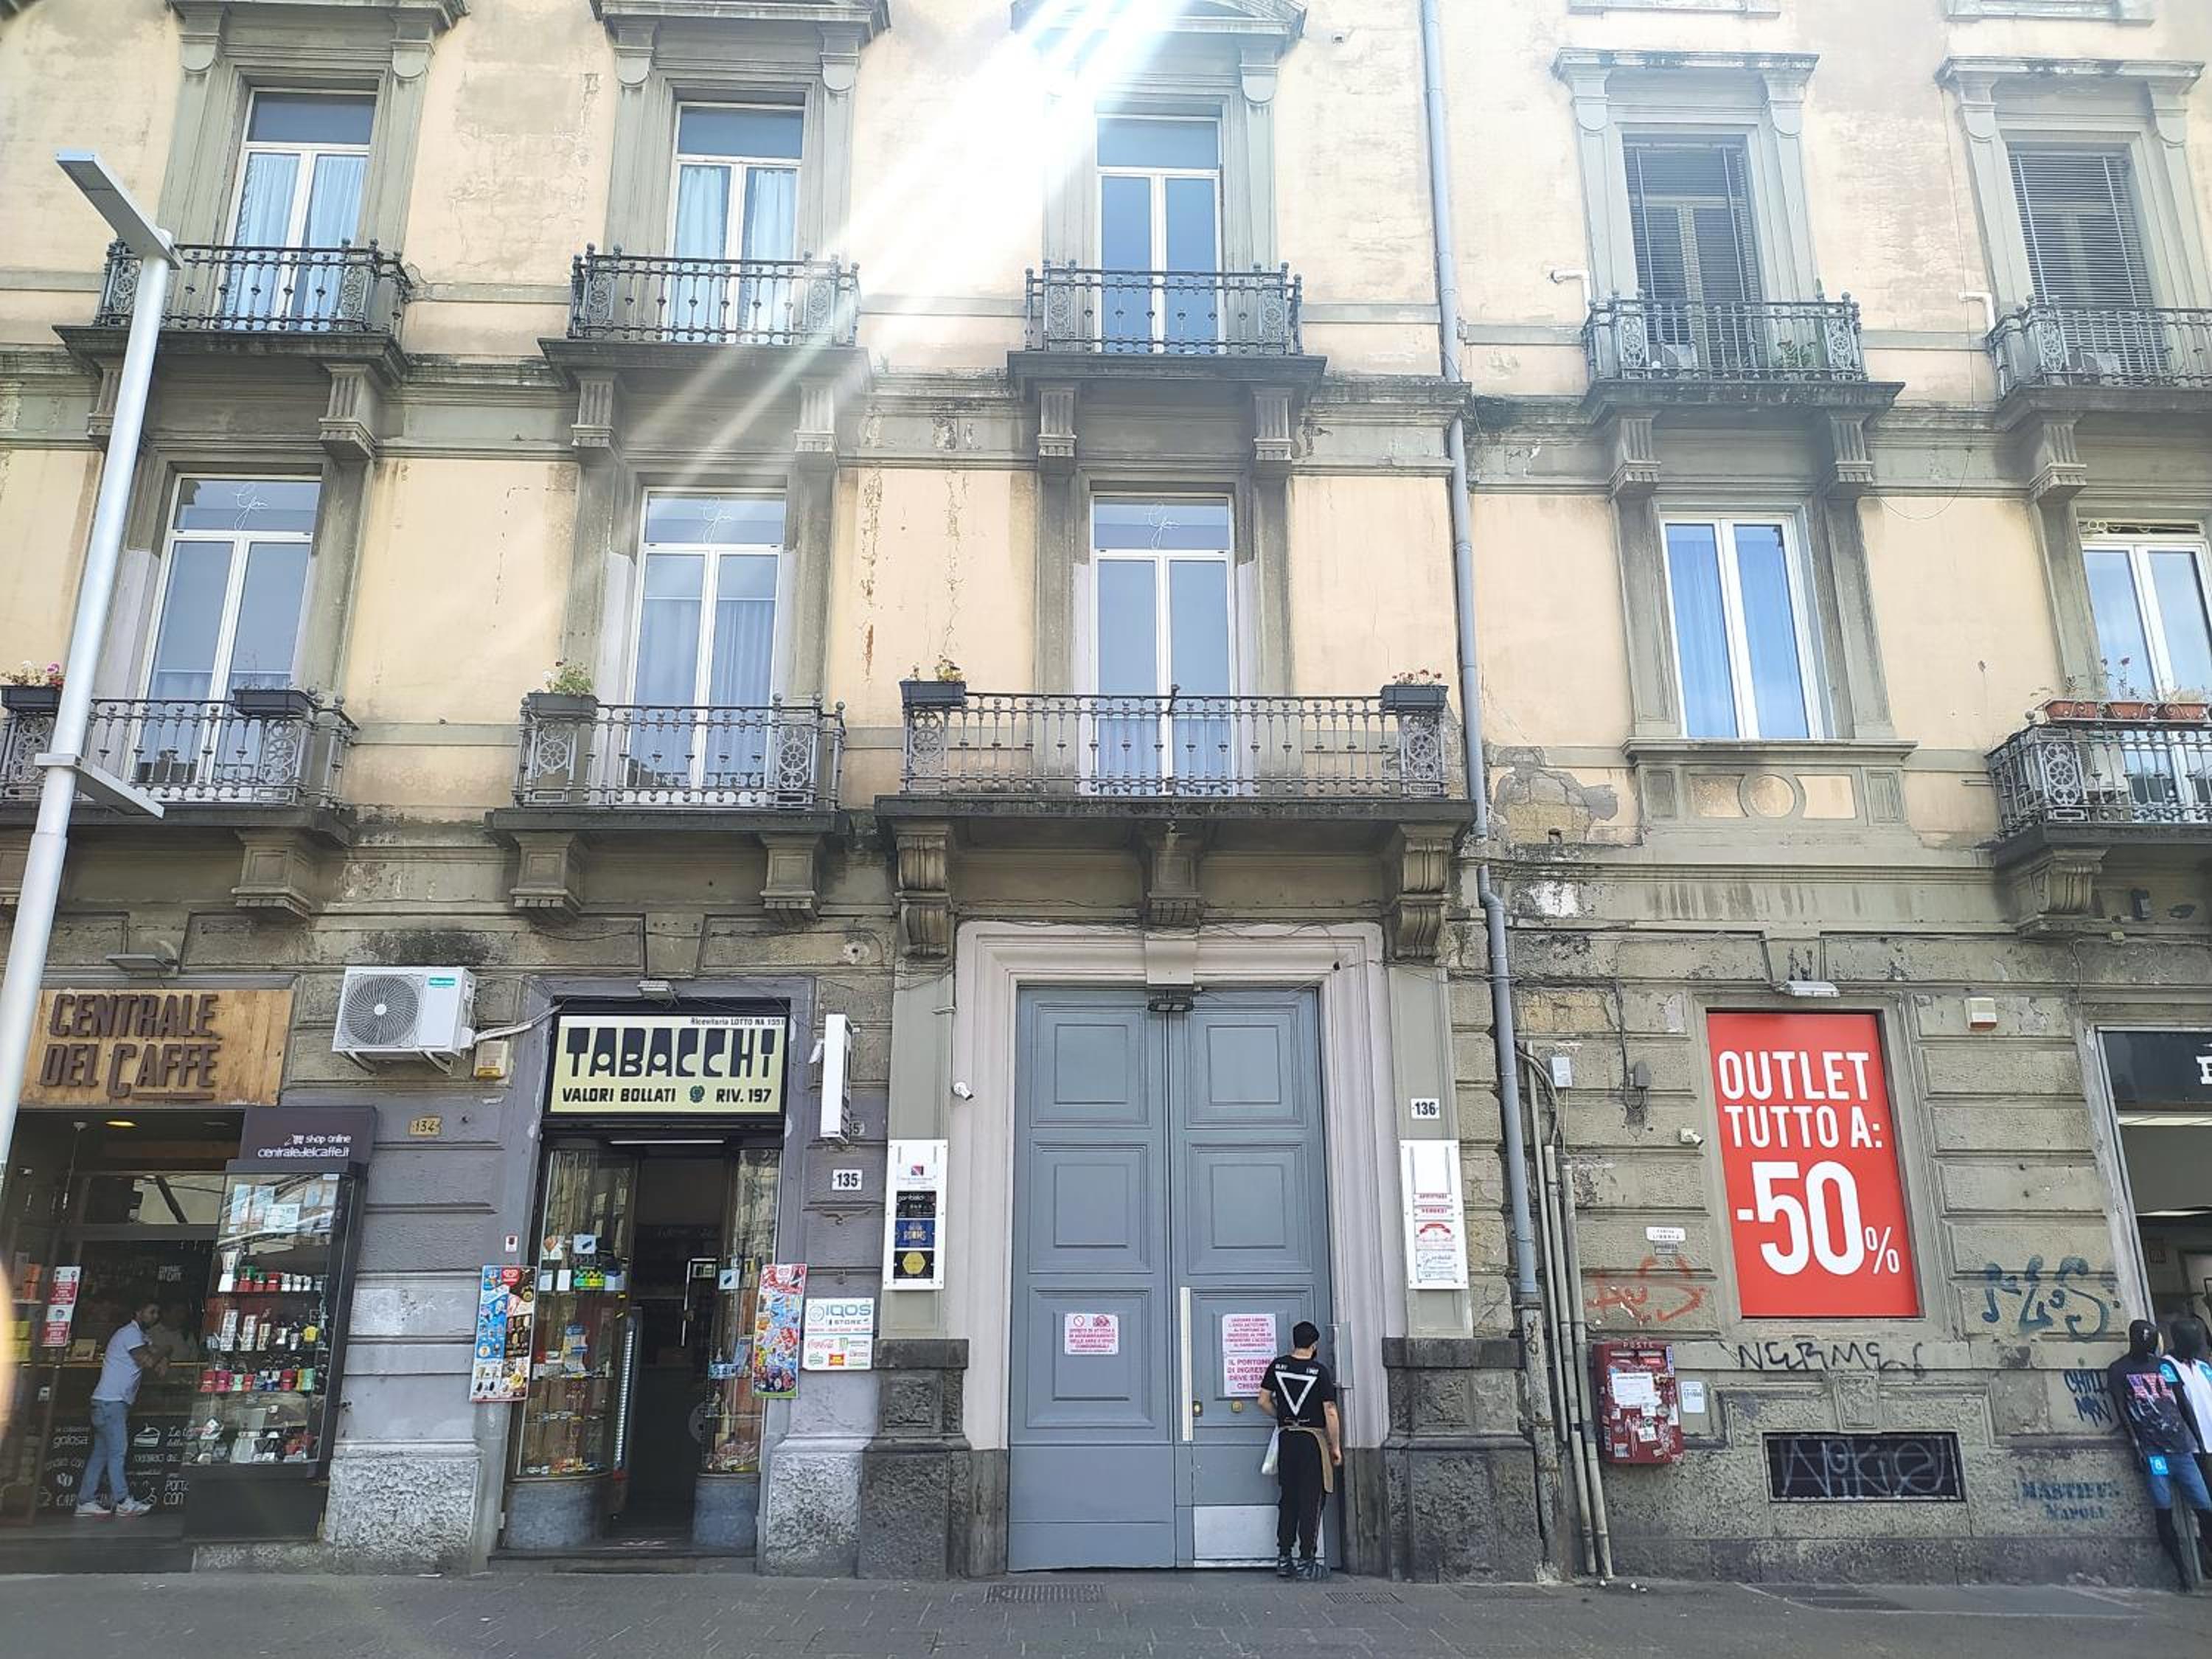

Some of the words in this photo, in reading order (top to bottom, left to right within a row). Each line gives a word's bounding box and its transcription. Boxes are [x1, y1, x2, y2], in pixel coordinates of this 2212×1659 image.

[49, 994, 220, 1037] CENTRALE
[39, 1043, 99, 1088] DEL
[106, 1043, 220, 1099] CAFFE
[566, 1027, 776, 1077] TABACCHI
[562, 1088, 613, 1102] VALORI
[620, 1088, 676, 1102] BOLLATI
[715, 1088, 744, 1103] RIV.
[748, 1088, 772, 1103] 197
[1718, 1051, 1869, 1101] OUTLET
[1415, 1102, 1436, 1116] 136
[1724, 1105, 1840, 1148] TUTTO
[1850, 1105, 1882, 1148] A:
[305, 1134, 324, 1144] shop
[327, 1134, 352, 1143] online
[837, 1172, 858, 1187] 135
[1736, 1161, 1900, 1276] -50%
[826, 1304, 872, 1318] IQOS
